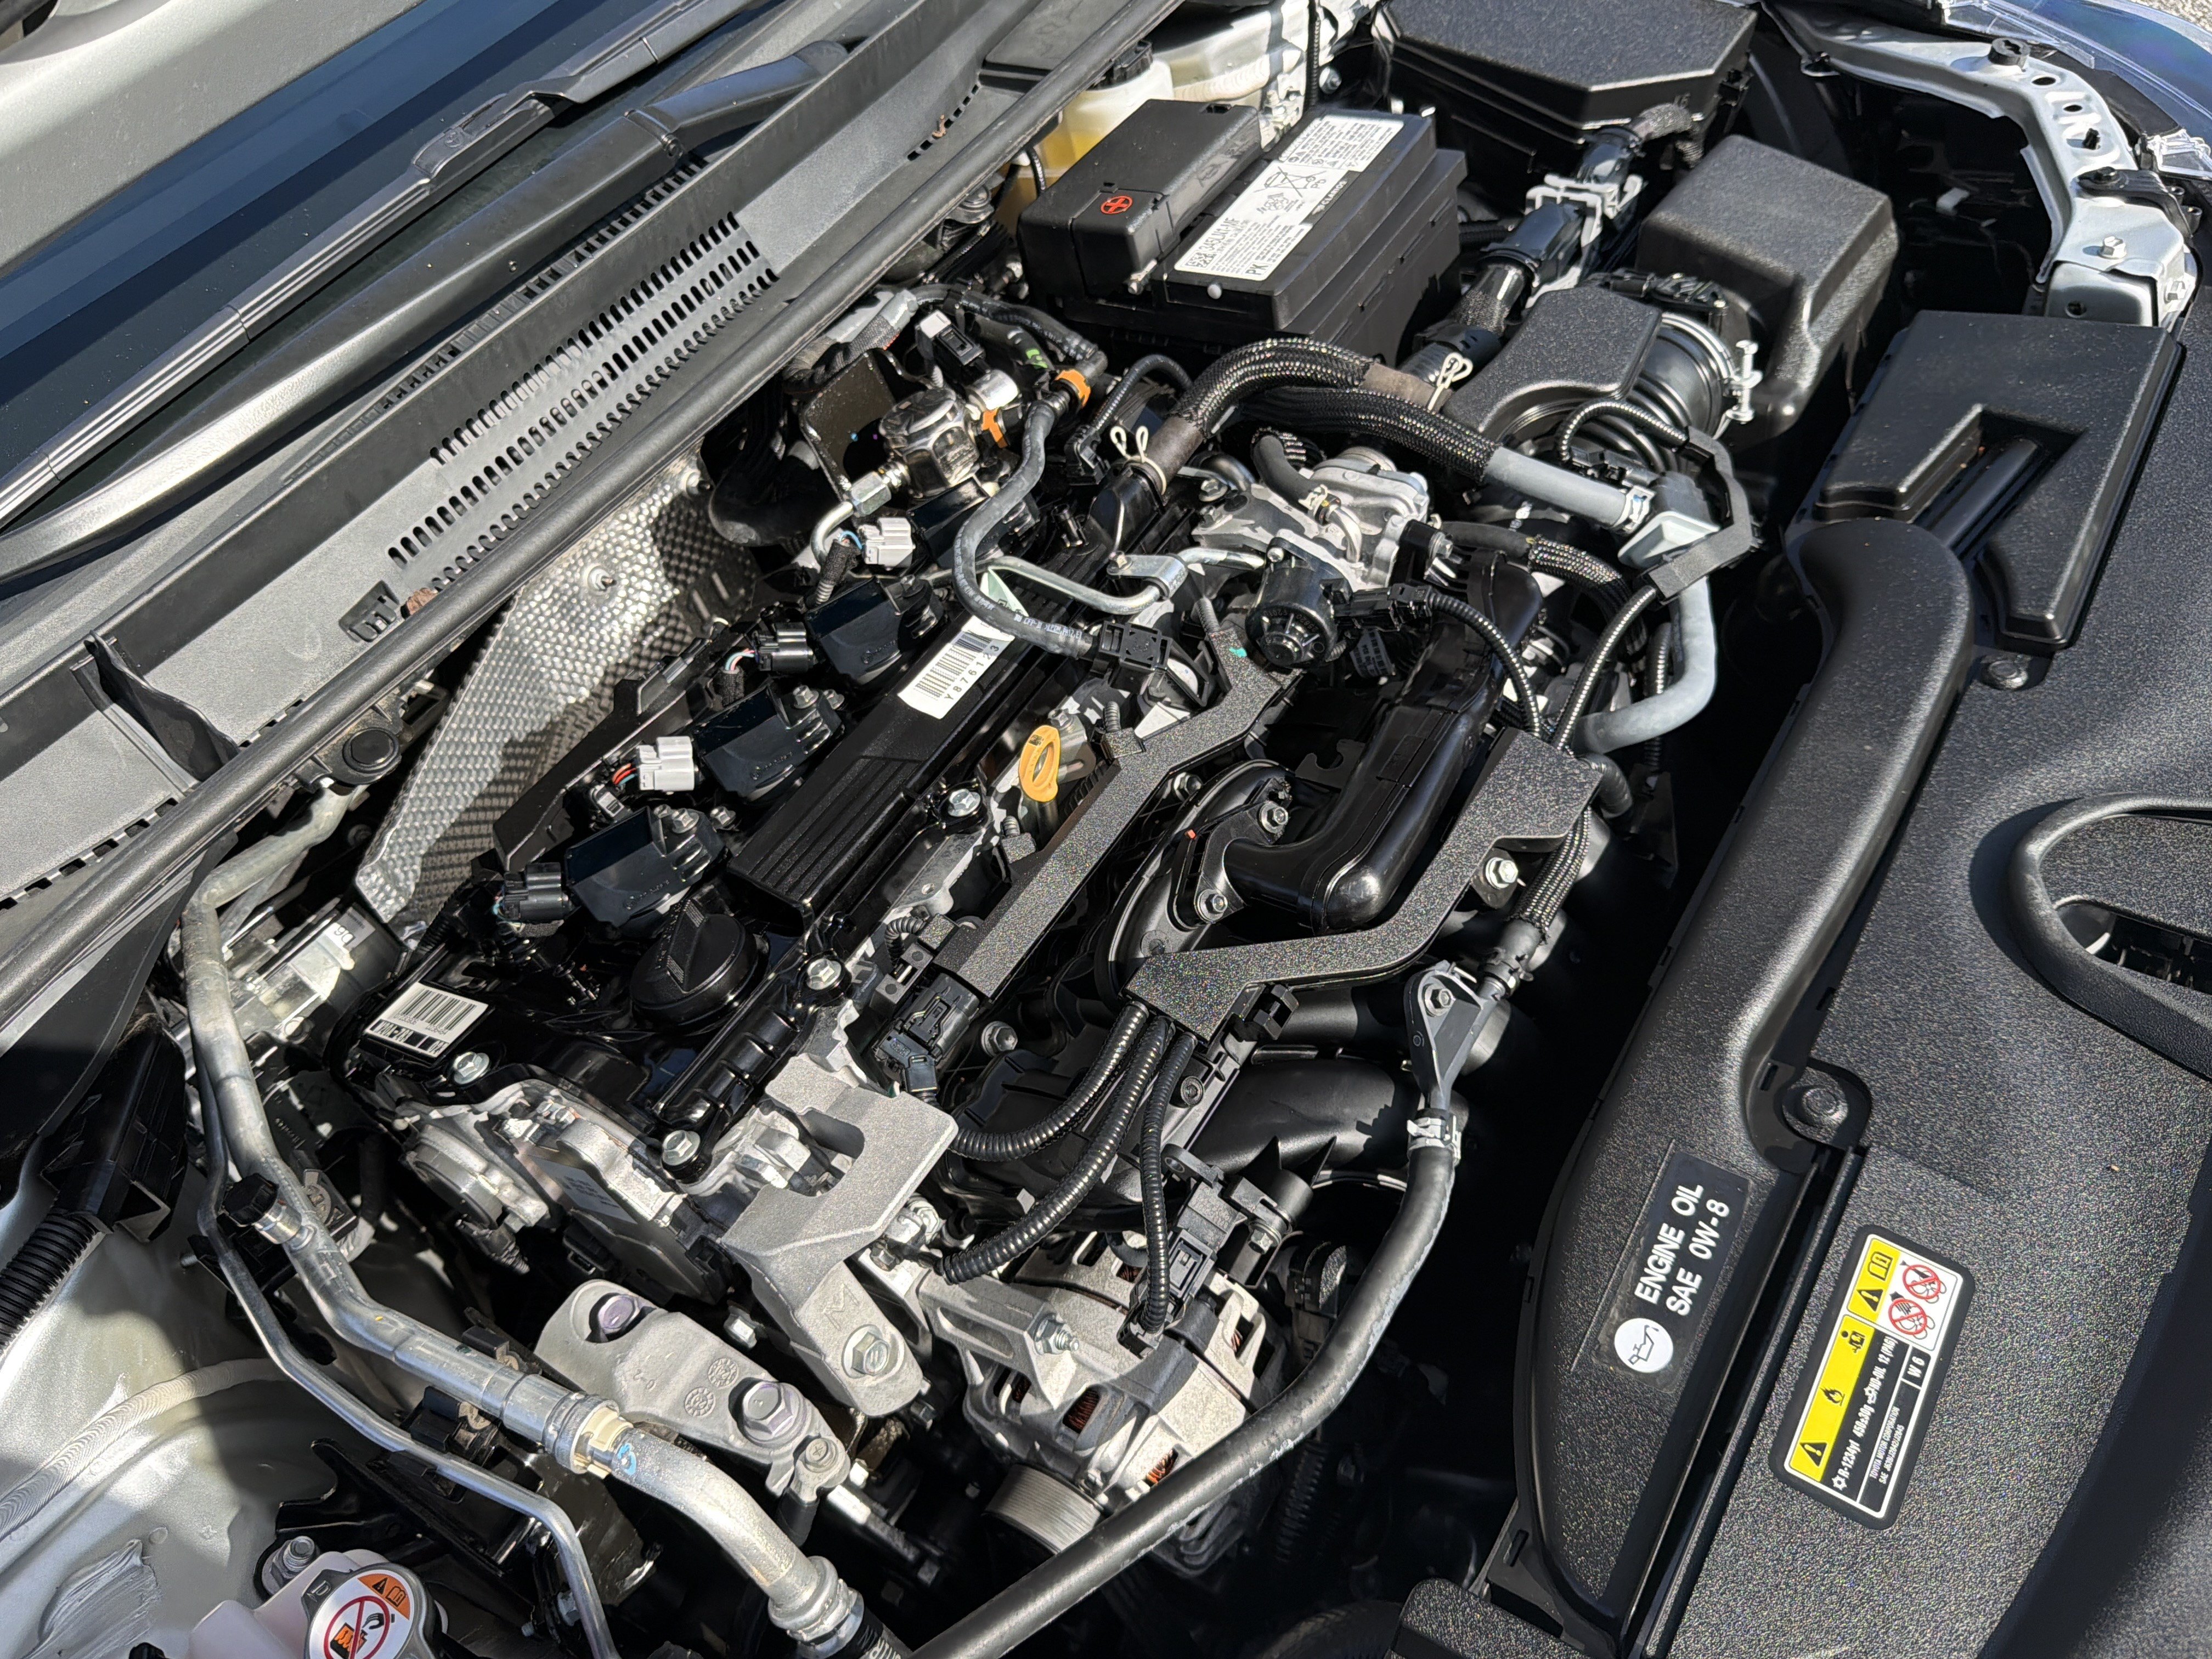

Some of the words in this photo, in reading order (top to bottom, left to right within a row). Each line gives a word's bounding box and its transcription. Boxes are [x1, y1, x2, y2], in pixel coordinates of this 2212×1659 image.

[1322, 179, 1347, 205] CLARIOS
[1634, 1223, 1685, 1304] ENGINE
[1672, 1185, 1704, 1216] OIL
[1666, 1267, 1702, 1316] SAE
[1689, 1199, 1730, 1260] 0W-8
[1907, 1364, 1922, 1378] W
[1912, 1356, 1925, 1367] 6
[1852, 1404, 1875, 1438] 450±30g
[1878, 1353, 1891, 1365] 12
[1869, 1459, 1882, 1479] TOYOTA
[1876, 1440, 1888, 1459] MOTOR
[1882, 1406, 1900, 1441] CORPORATION
[1878, 1471, 1889, 1484] SAE
